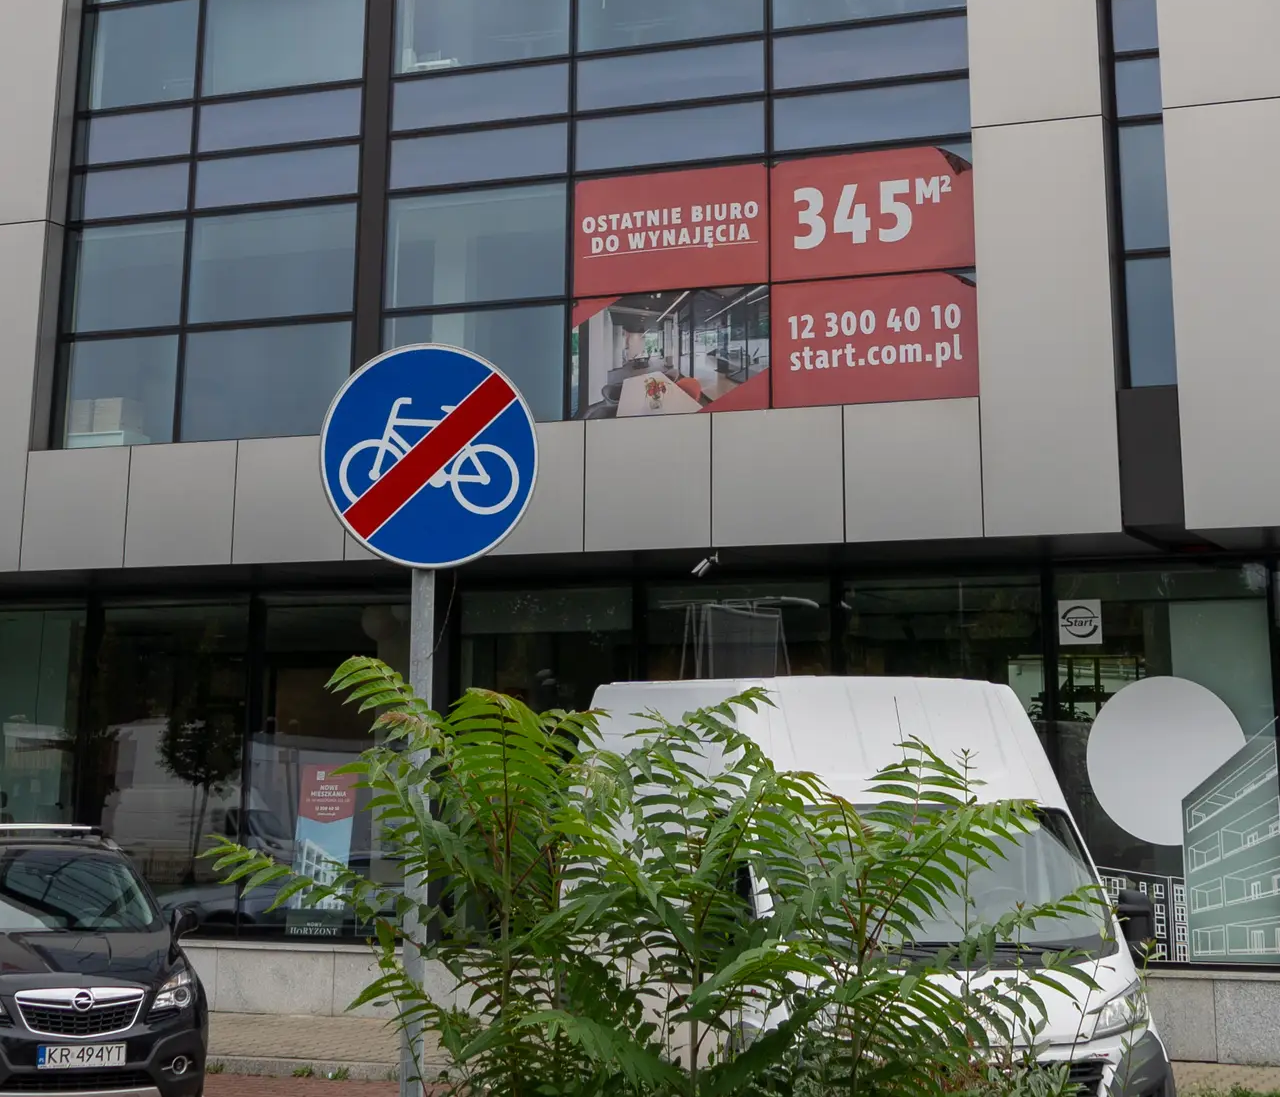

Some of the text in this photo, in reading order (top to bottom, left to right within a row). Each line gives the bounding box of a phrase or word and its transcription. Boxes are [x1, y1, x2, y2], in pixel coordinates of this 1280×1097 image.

[582, 201, 759, 234] OSTATNIE BIURO
[591, 222, 751, 253] DO WYNAJĘCIA
[787, 303, 961, 340] 12 300 40 10
[790, 333, 963, 371] start.com.pl
[47, 1045, 124, 1064] KR 494YT
